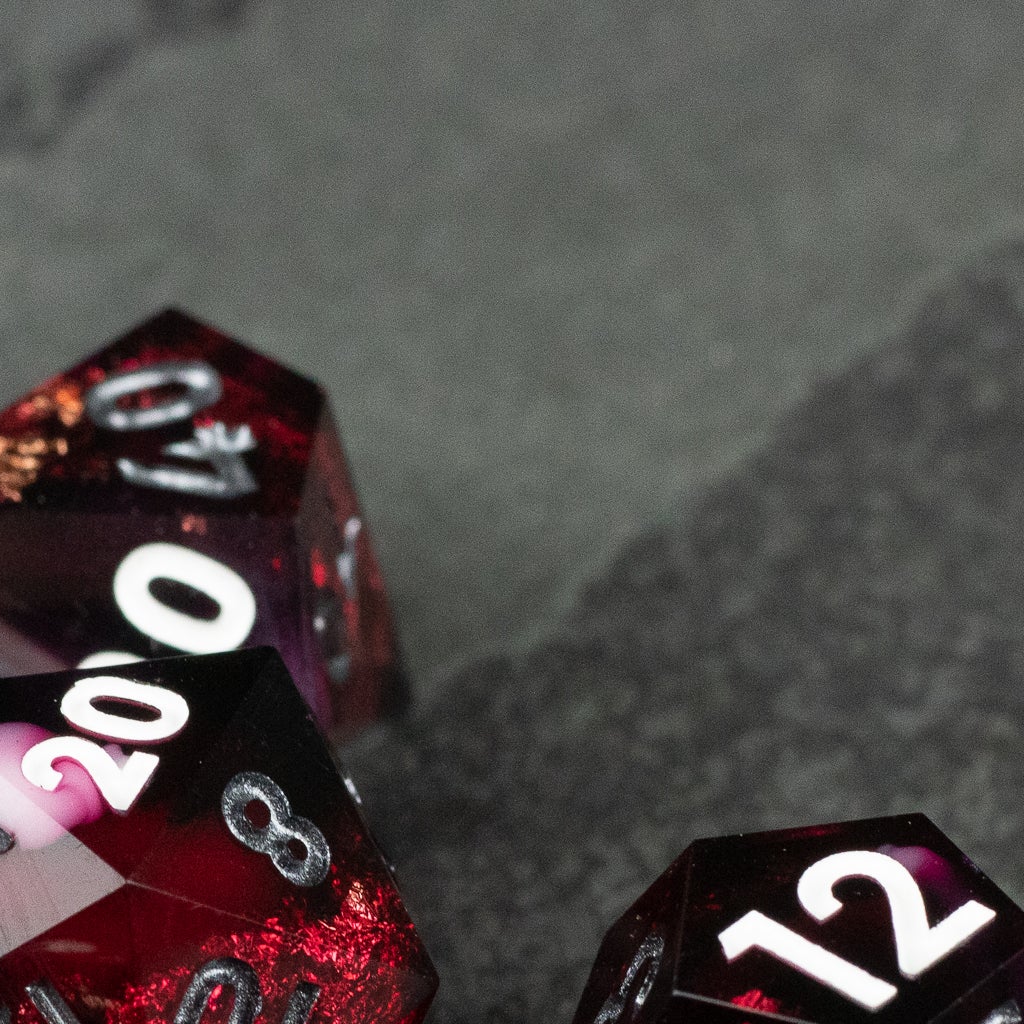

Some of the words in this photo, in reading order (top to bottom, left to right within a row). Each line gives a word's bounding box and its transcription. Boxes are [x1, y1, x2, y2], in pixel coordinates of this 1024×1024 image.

[20, 675, 190, 812] 20
[222, 771, 331, 888] 8
[718, 850, 997, 1012] 12
